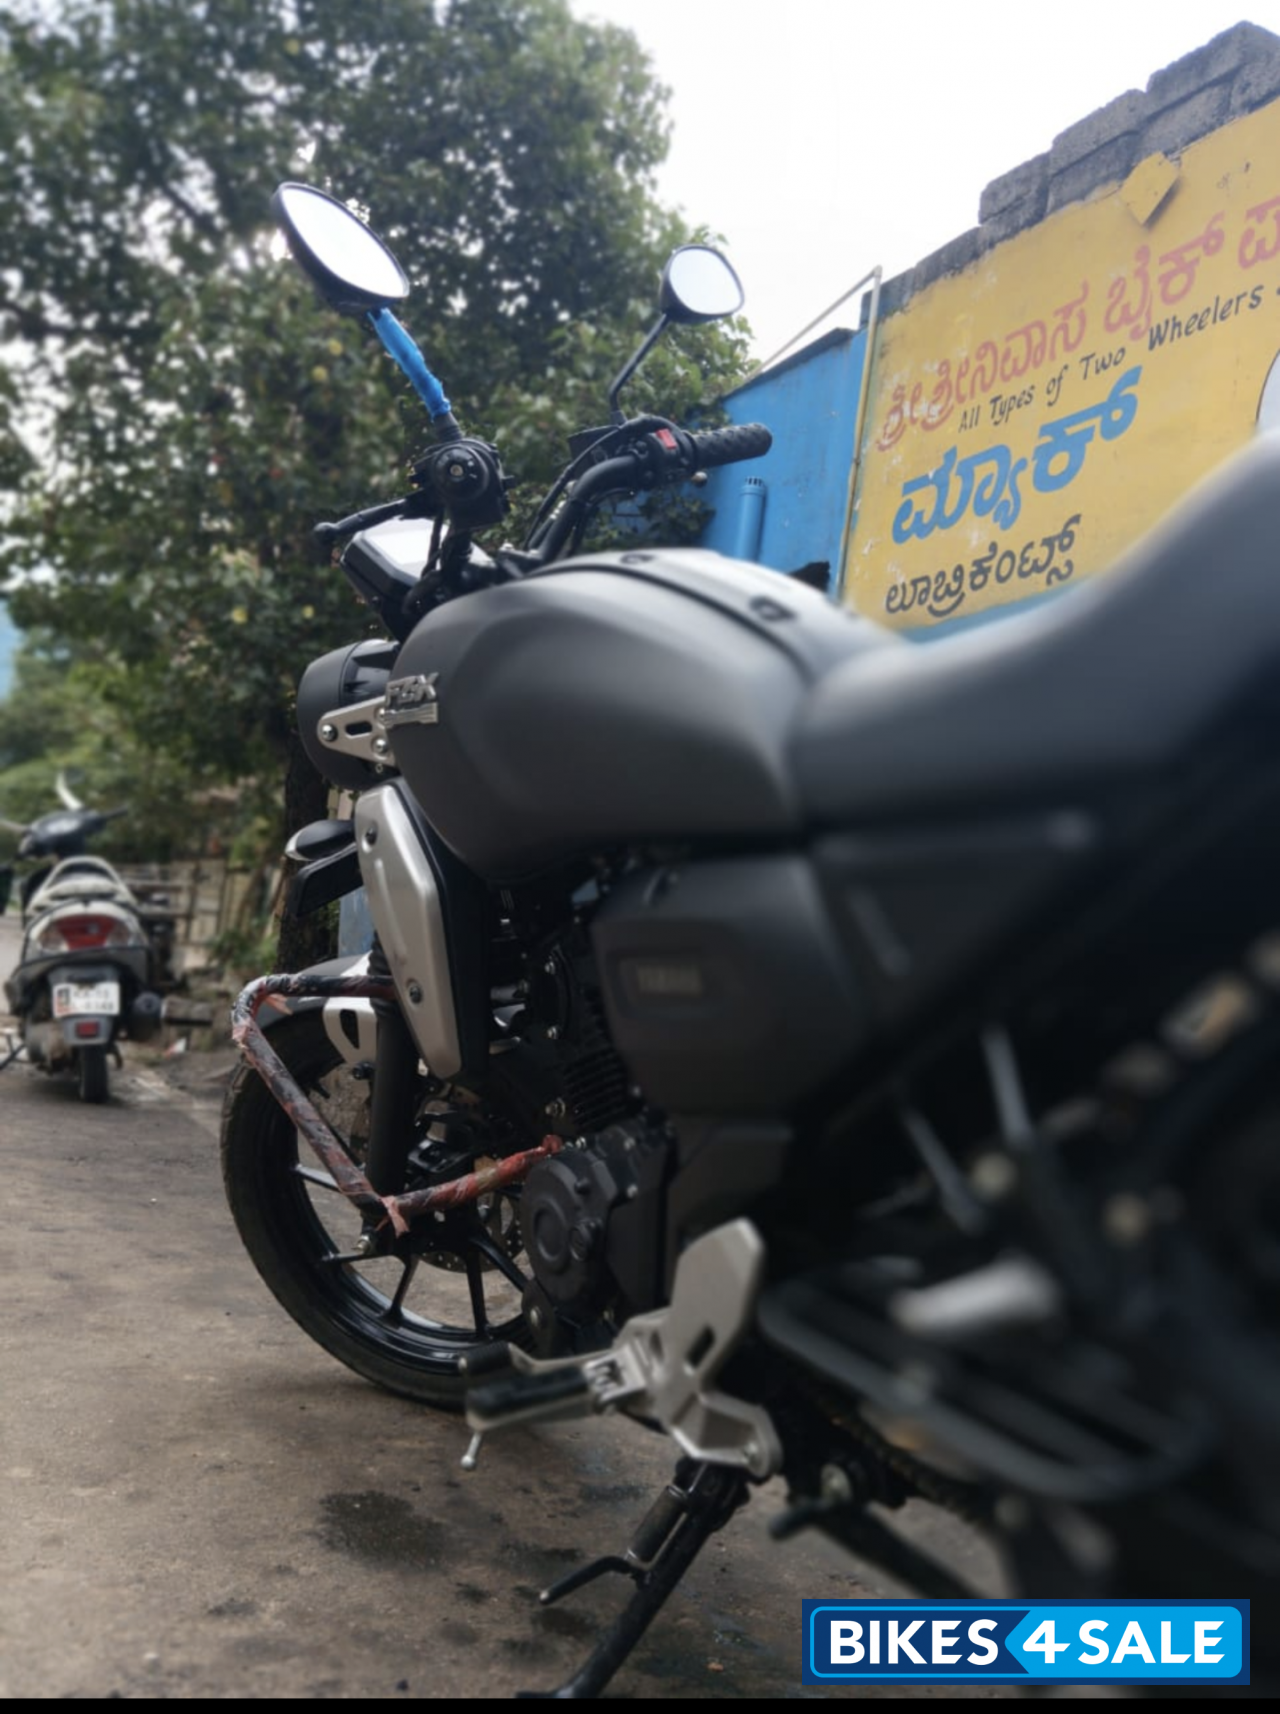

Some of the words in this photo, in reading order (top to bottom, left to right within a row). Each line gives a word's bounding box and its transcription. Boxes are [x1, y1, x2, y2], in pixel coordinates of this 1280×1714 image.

[1103, 210, 1226, 342] ಬೈಕ್
[958, 404, 981, 433] All
[989, 384, 1035, 426] Types
[1046, 364, 1069, 407] of
[1079, 346, 1127, 381] Two
[1148, 284, 1265, 352] Wheelers
[891, 364, 1144, 545] ಮ್ಯಾಕ್
